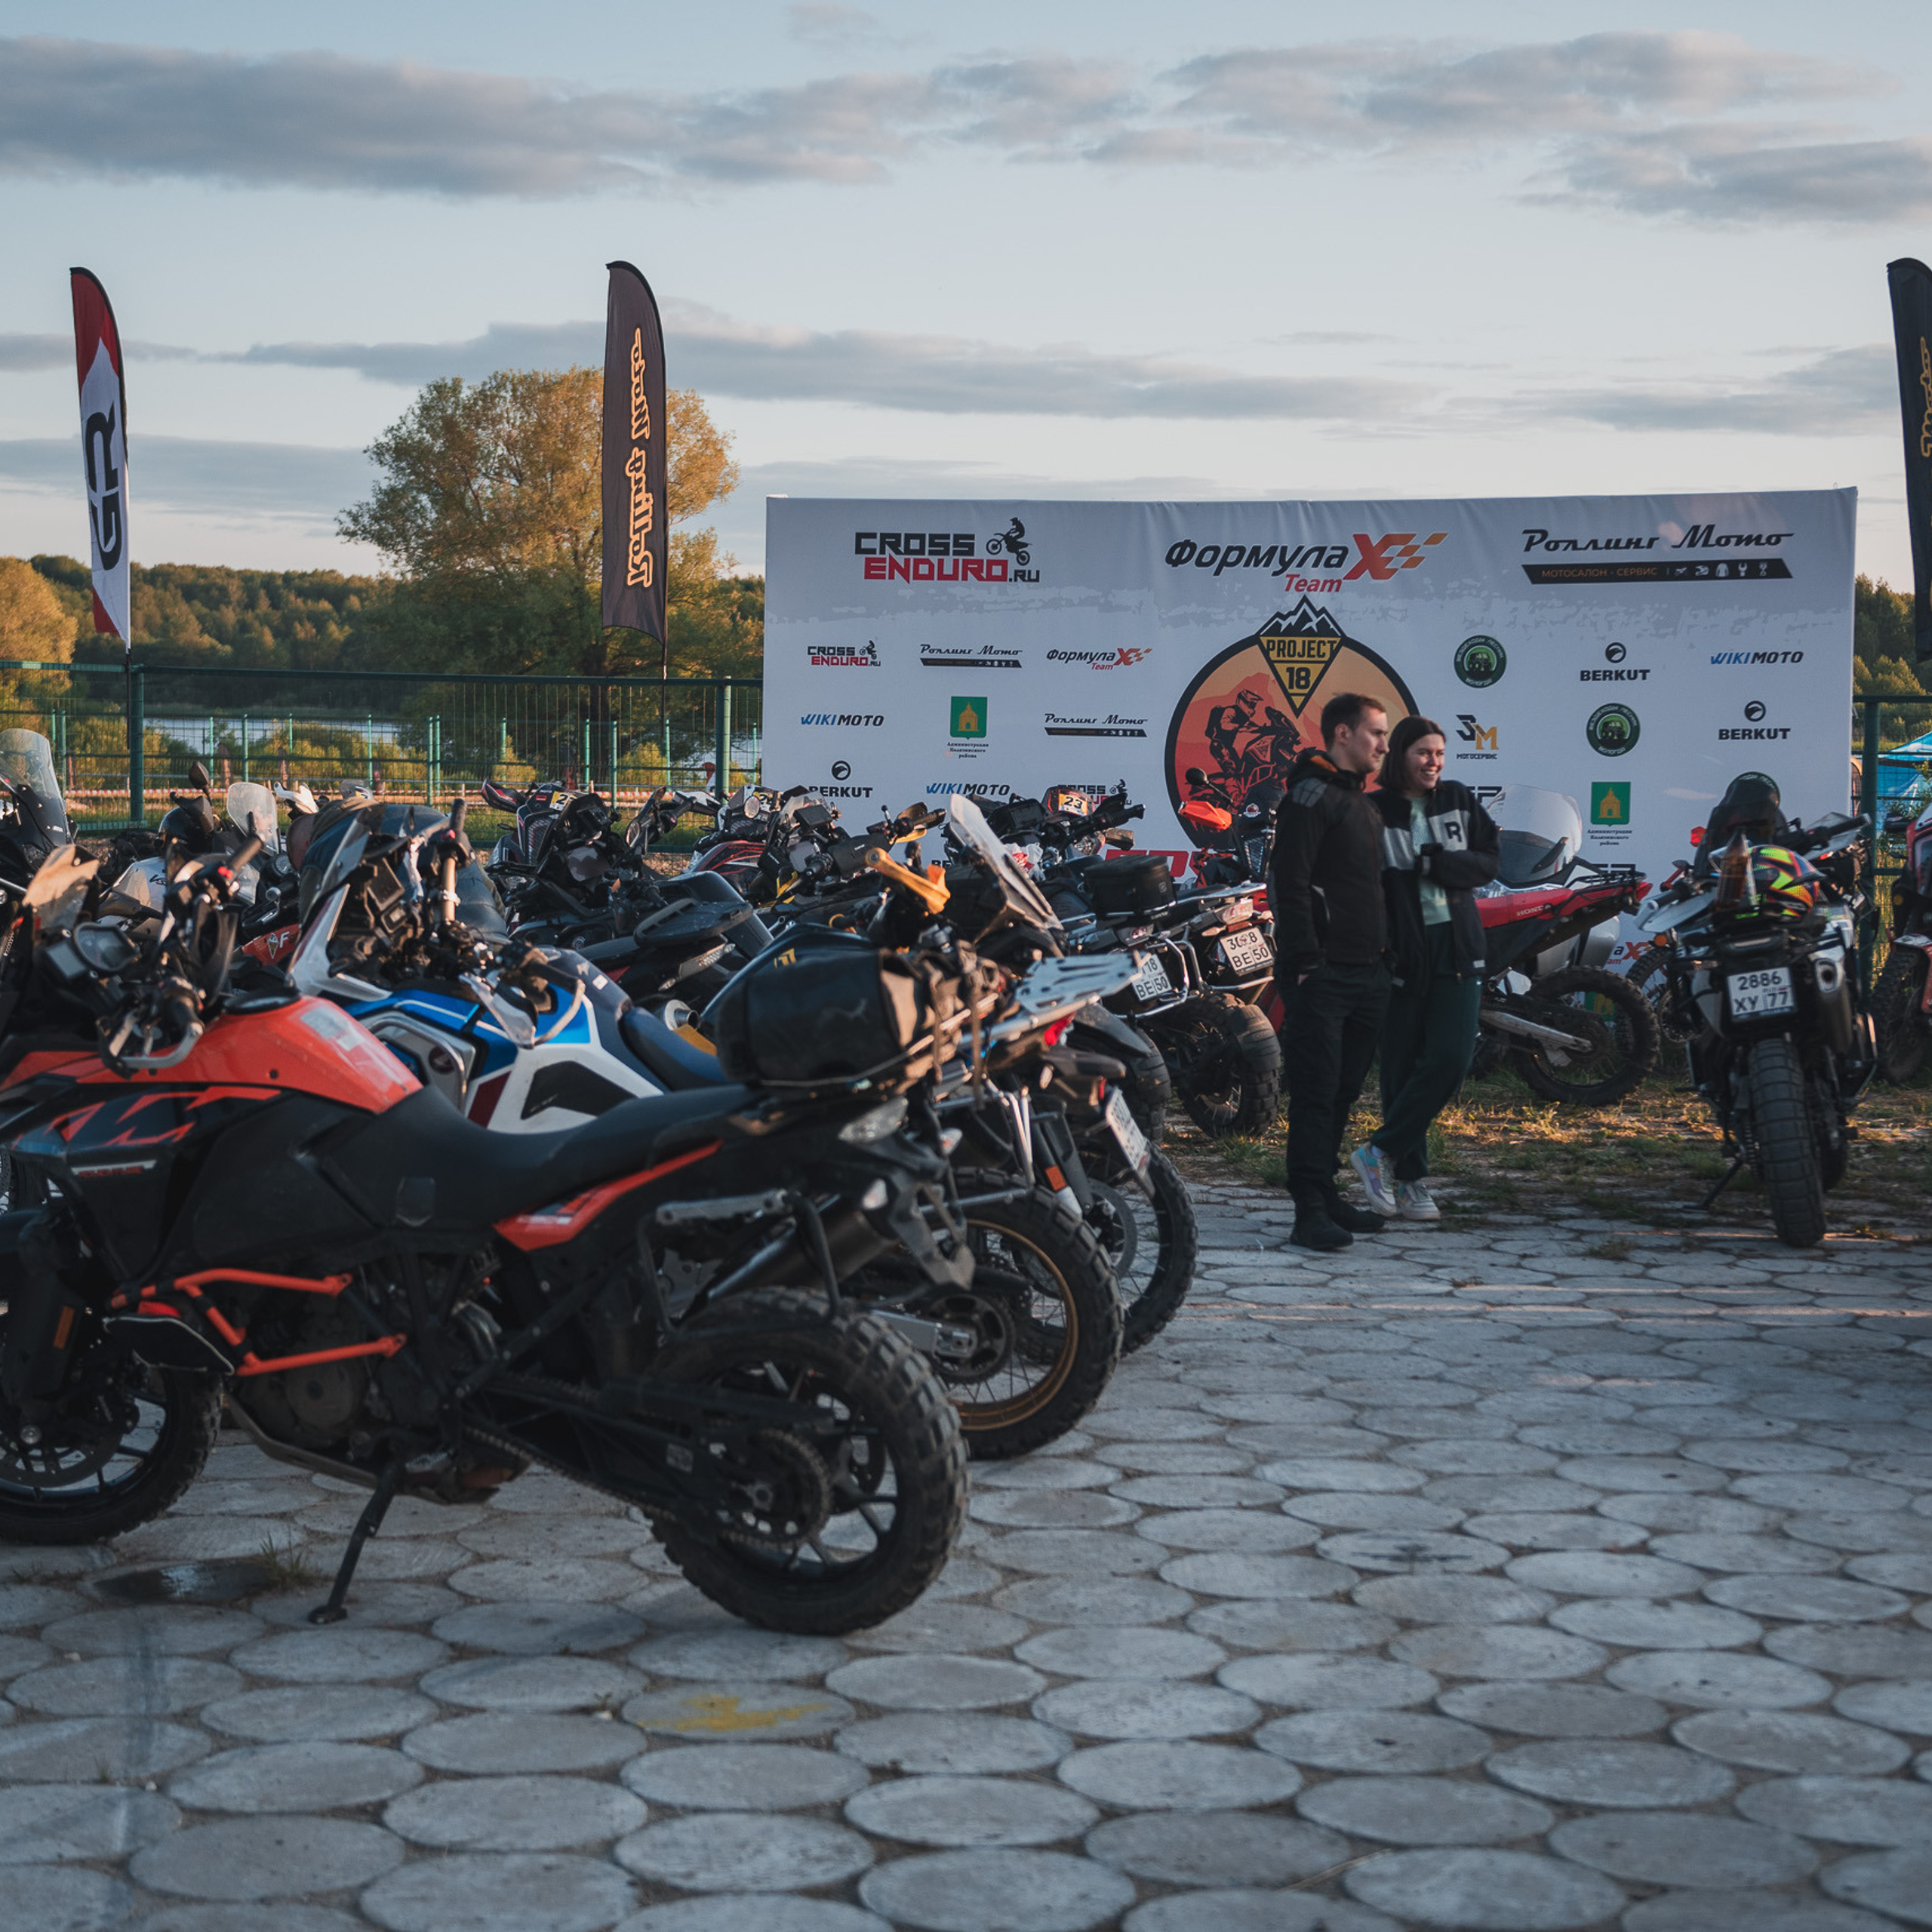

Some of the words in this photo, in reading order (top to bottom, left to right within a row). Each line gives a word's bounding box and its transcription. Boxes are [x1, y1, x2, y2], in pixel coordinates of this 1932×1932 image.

[85, 401, 122, 571] GR
[855, 532, 975, 556] CROSS
[1521, 528, 1660, 552] Роллинг
[1672, 524, 1794, 549] Мото
[1542, 569, 1607, 578] МОТОСАЛОН
[1617, 568, 1658, 577] СЕРВИС
[1284, 574, 1343, 593] Team
[808, 646, 855, 656] CROSS
[920, 644, 973, 654] Роллинг
[977, 645, 1023, 655] Мото
[1266, 638, 1335, 659] PROJECT
[1710, 651, 1804, 664] WIKIMOTO
[1091, 662, 1114, 670] Team
[1286, 666, 1311, 690] 18
[1580, 669, 1651, 681] BERKUT
[801, 714, 884, 727] WIKIMOTO
[1044, 712, 1097, 724] Роллинг
[1102, 714, 1148, 724] Мото
[1718, 728, 1791, 740] BERKUT
[926, 783, 1011, 795] WIKIMOTO
[1063, 796, 1083, 810] 23
[1444, 821, 1463, 843] R
[1253, 946, 1269, 960] 50
[1155, 977, 1168, 991] 50
[1737, 971, 1782, 991] 2886
[1767, 991, 1788, 1008] 77
